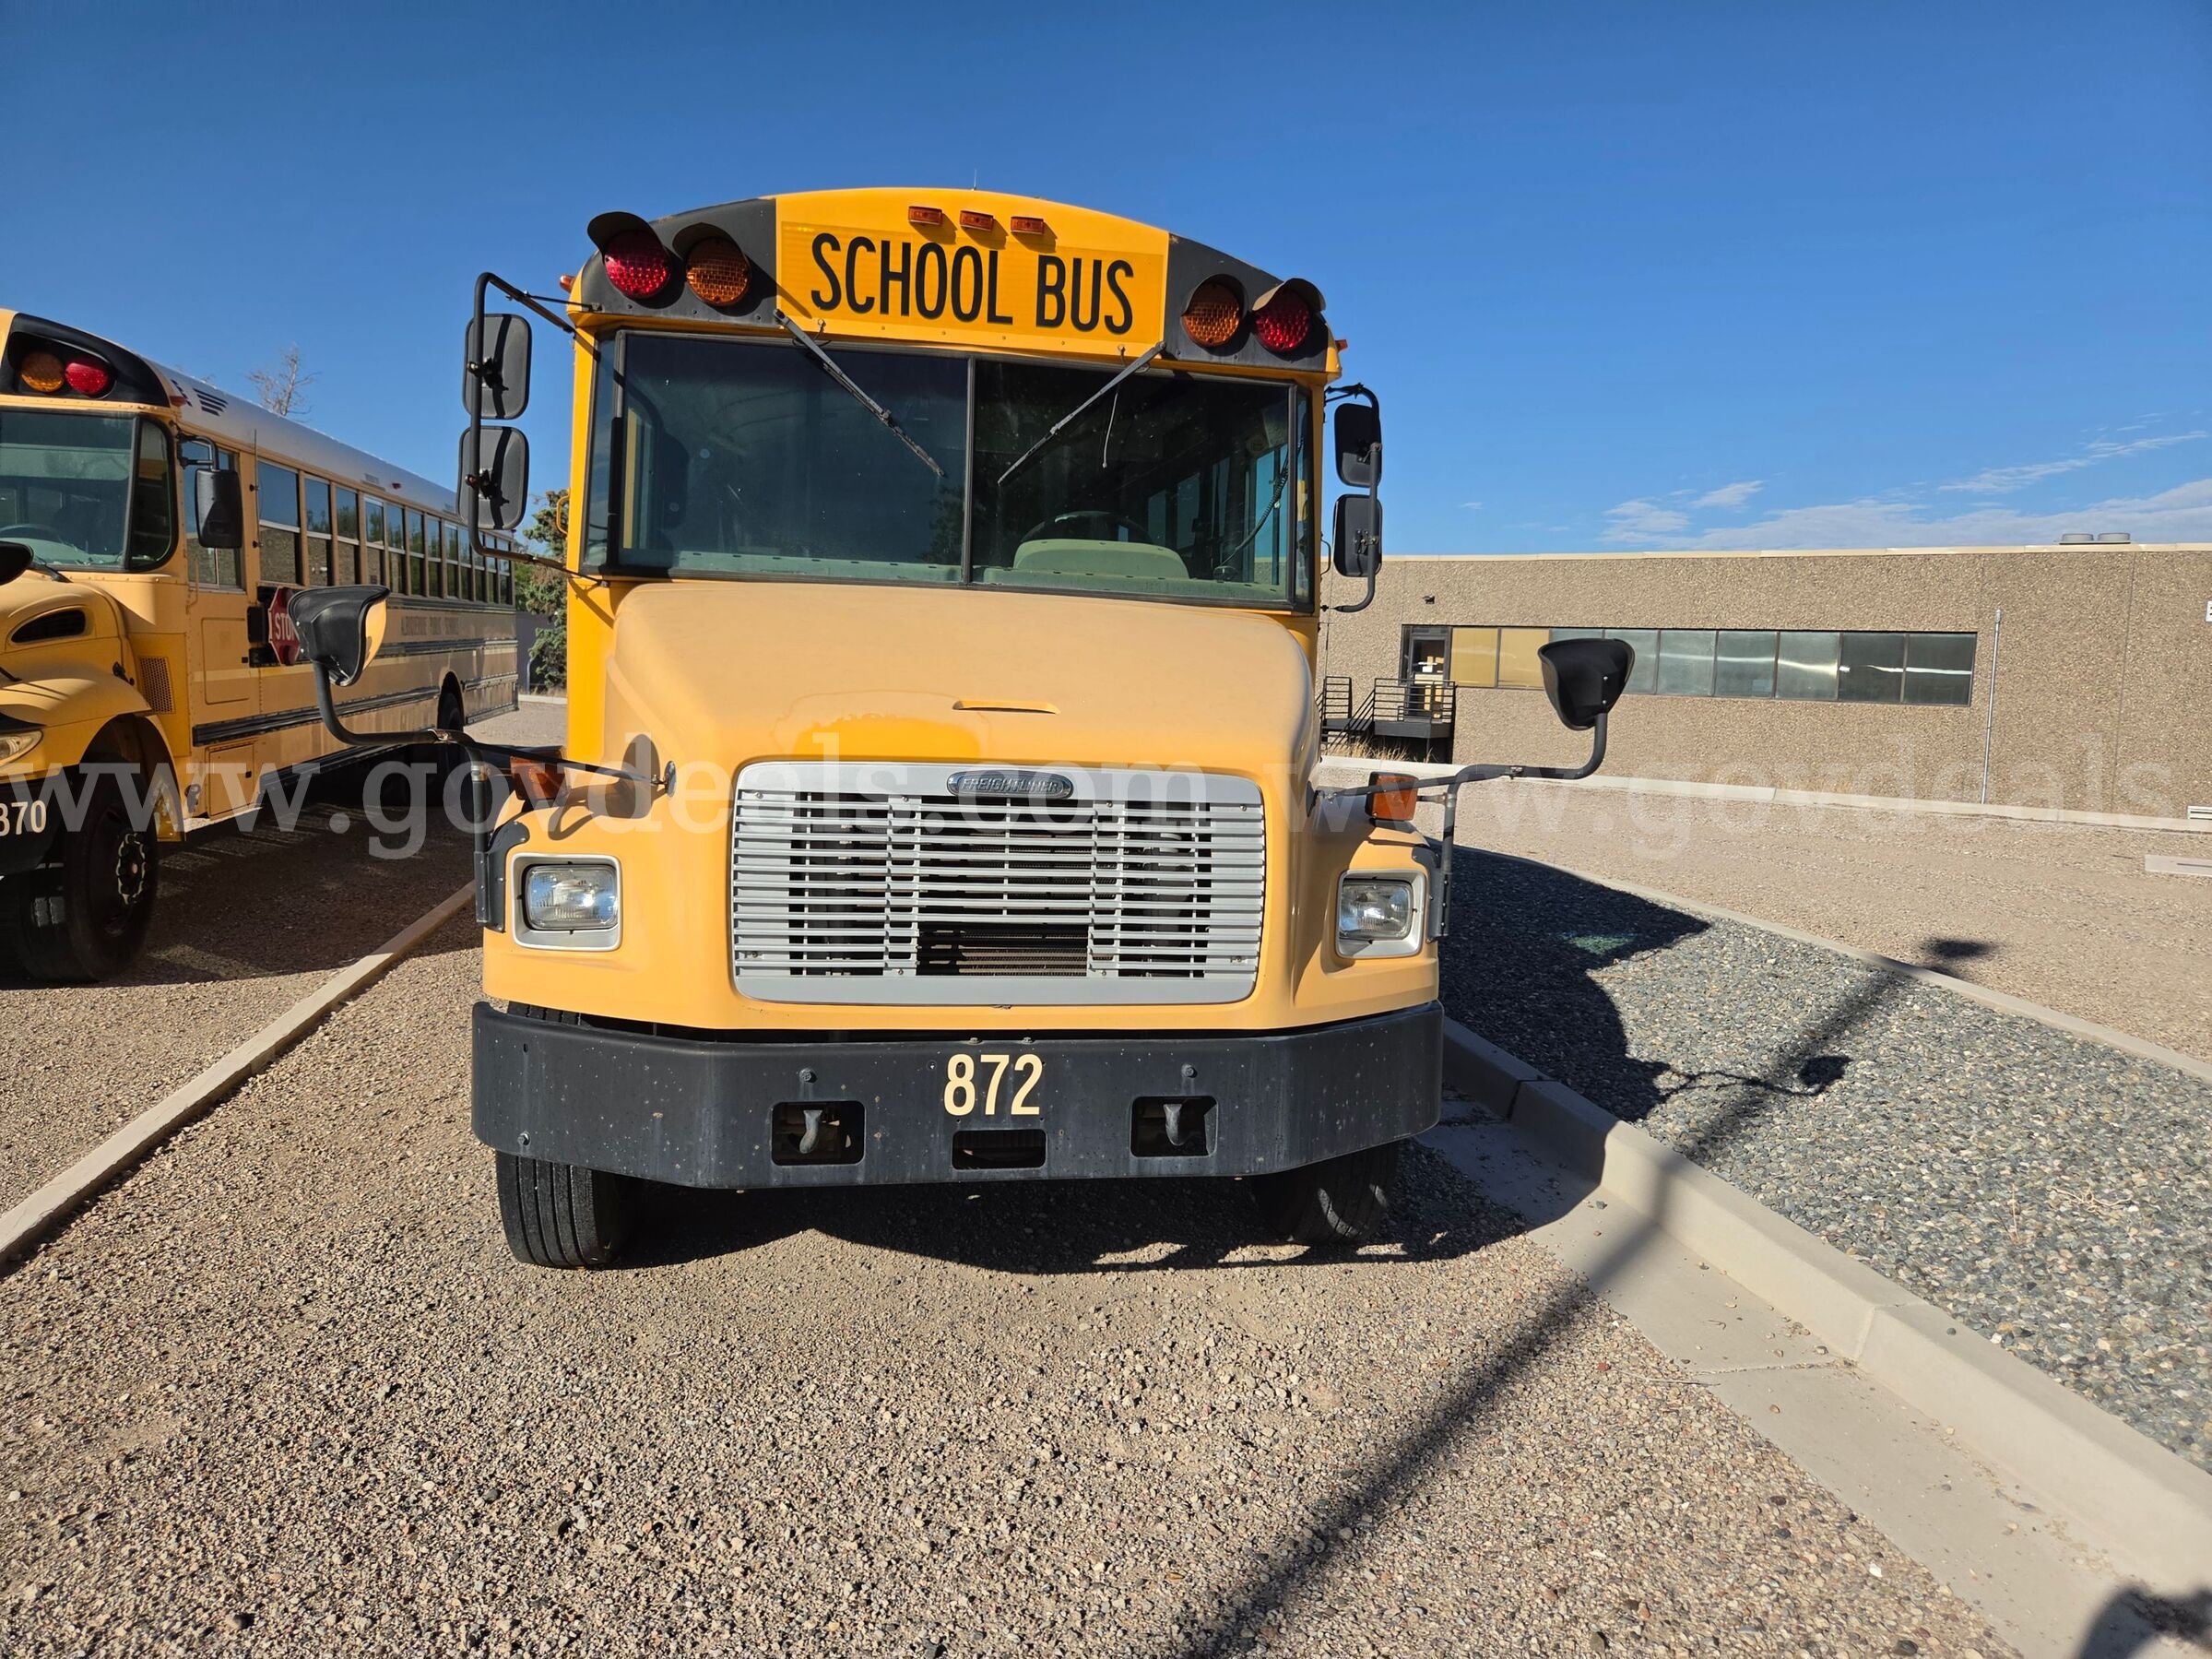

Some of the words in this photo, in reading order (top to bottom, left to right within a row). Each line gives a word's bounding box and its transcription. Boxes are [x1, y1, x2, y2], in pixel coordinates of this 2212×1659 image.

[810, 231, 1013, 326] SCHOOL
[1035, 254, 1134, 335] BUS
[961, 776, 1059, 793] FREIGHTLINER
[943, 1053, 1043, 1116] 872
